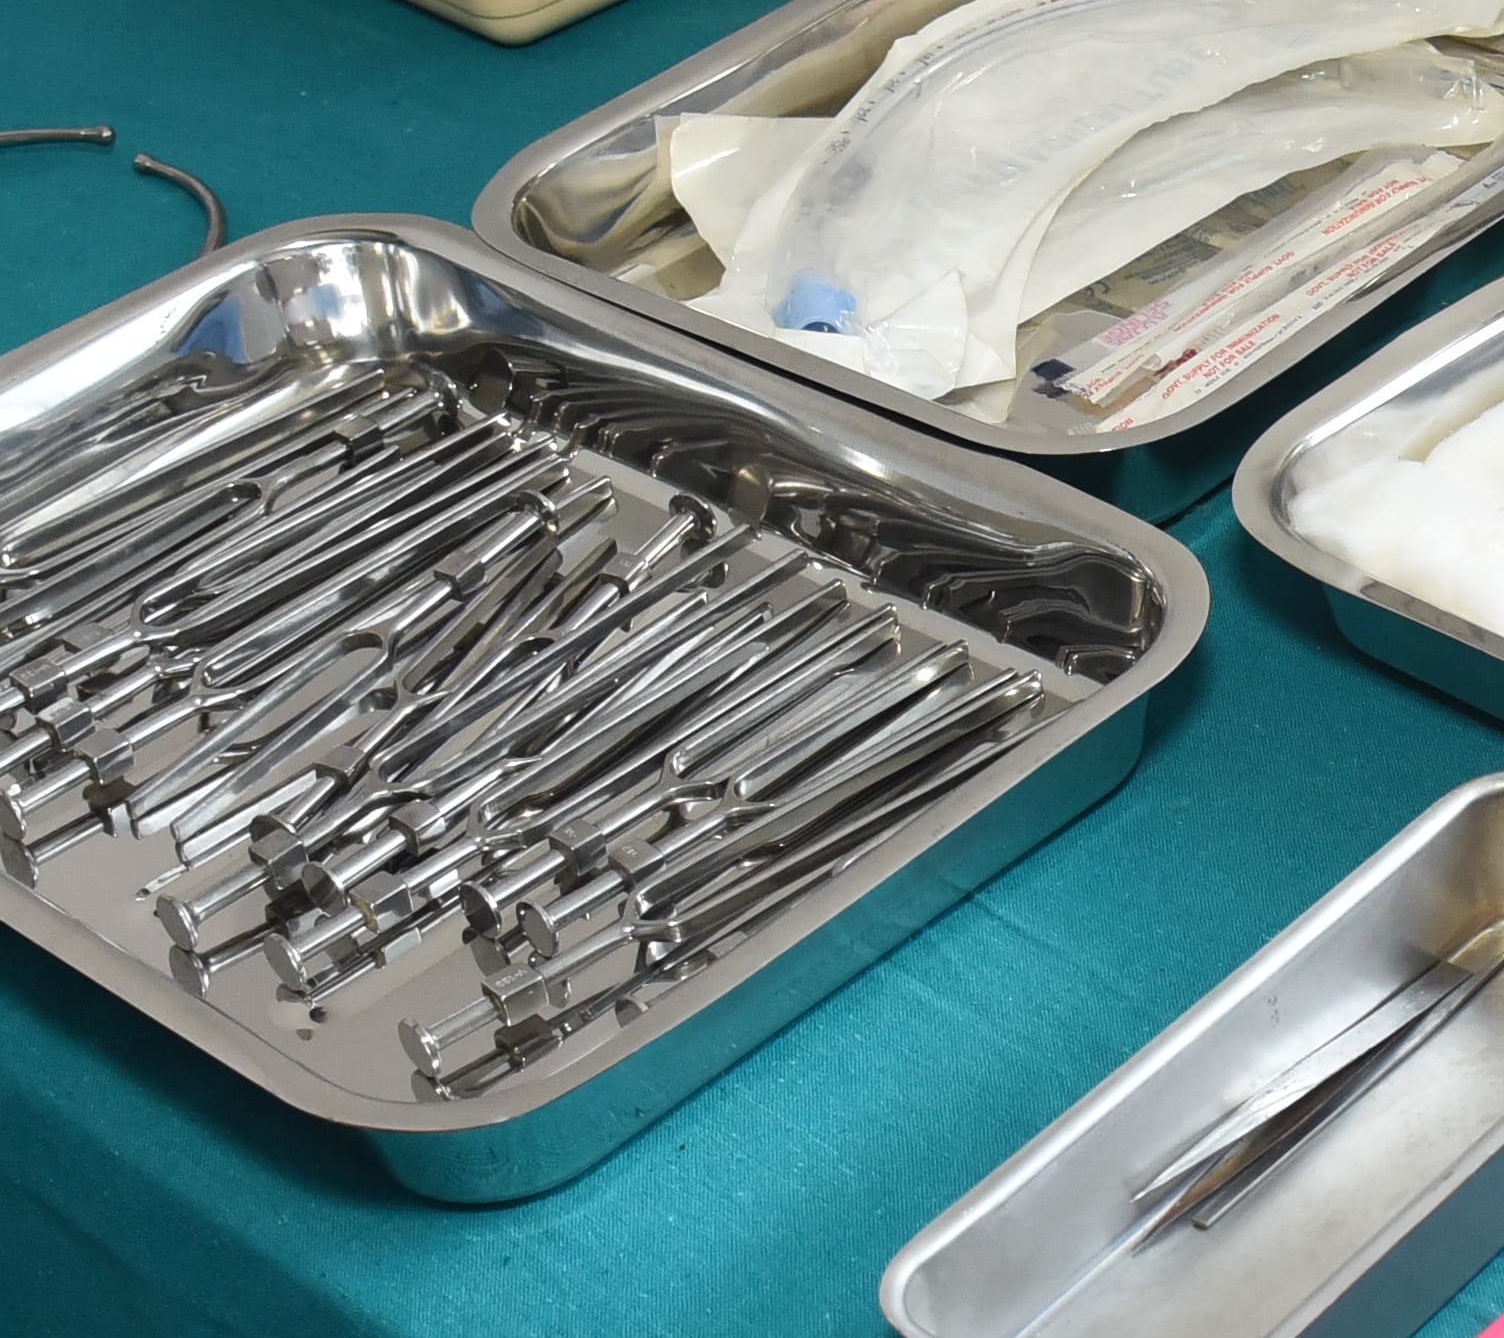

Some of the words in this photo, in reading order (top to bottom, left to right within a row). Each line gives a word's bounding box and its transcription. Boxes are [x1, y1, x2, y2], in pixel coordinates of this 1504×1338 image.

[1209, 345, 1229, 362] FOR
[1202, 363, 1221, 379] NOT
[1218, 352, 1237, 368] FOR
